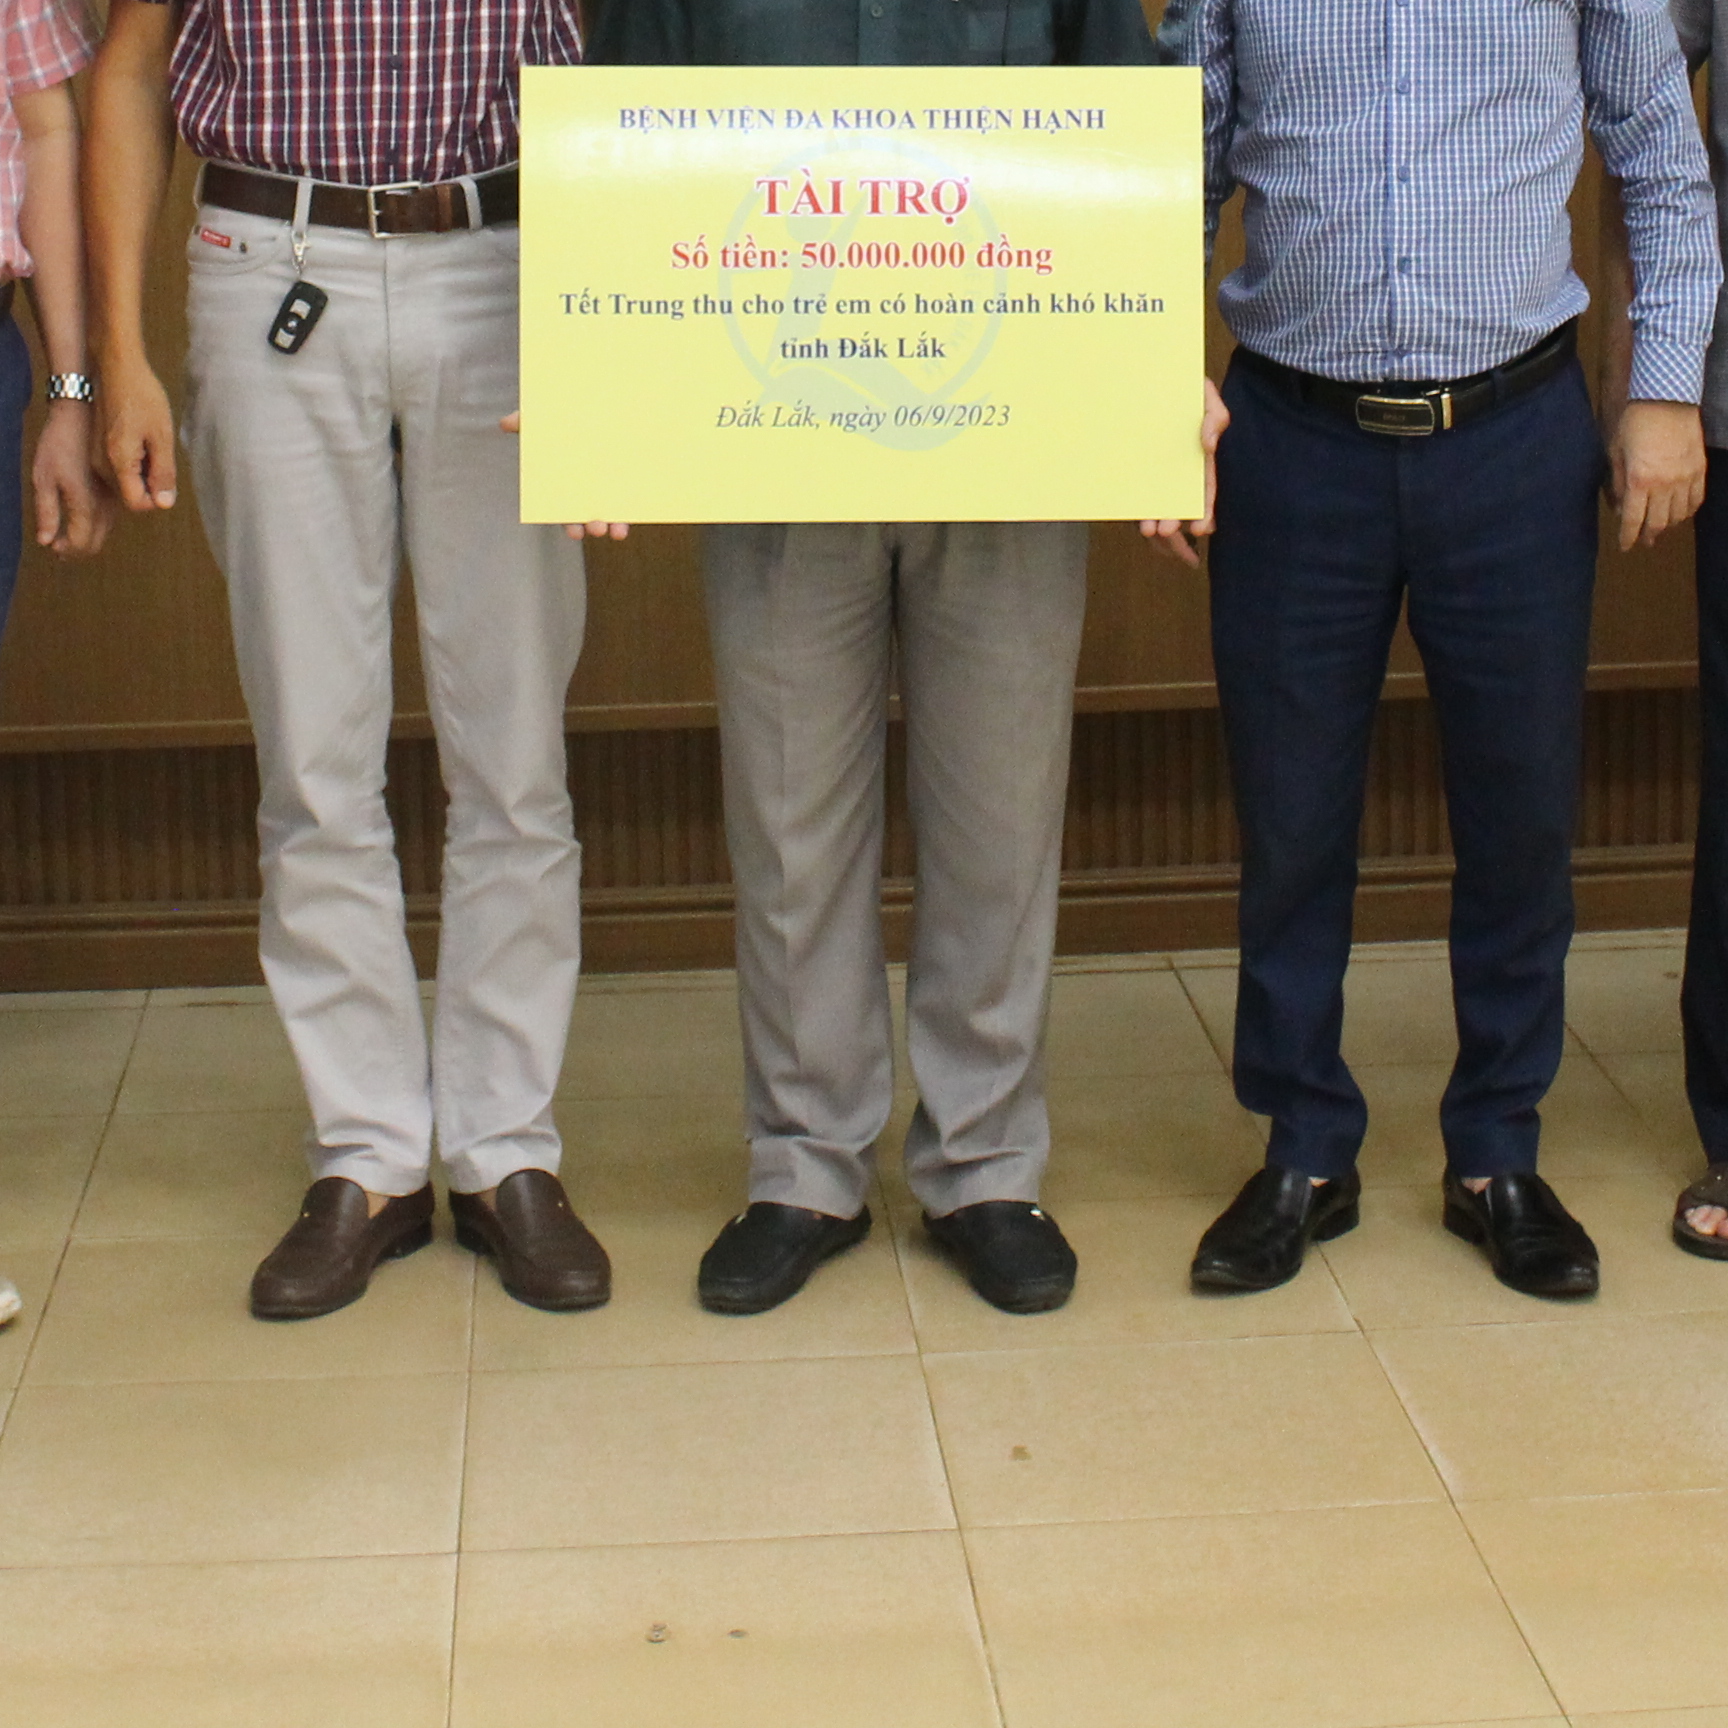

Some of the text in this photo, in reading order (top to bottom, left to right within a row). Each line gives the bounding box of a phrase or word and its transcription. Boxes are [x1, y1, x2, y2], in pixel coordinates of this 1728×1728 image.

[618, 106, 1105, 135] BỆNH VIỆN ĐA KHOA THIỆN HẠNH
[756, 168, 970, 225] TÀI TRỢ
[671, 233, 1053, 275] Số tiền: 50.000.000 đồng
[558, 287, 1165, 320] Tết Trung thu cho trẻ em có hoàn cảnh khó khăn
[780, 336, 829, 360] tỉnh
[837, 330, 889, 359] Đắk
[897, 330, 946, 359] Lắk
[716, 399, 1011, 433] Đắk Lắk, ngày 06/9/2023
